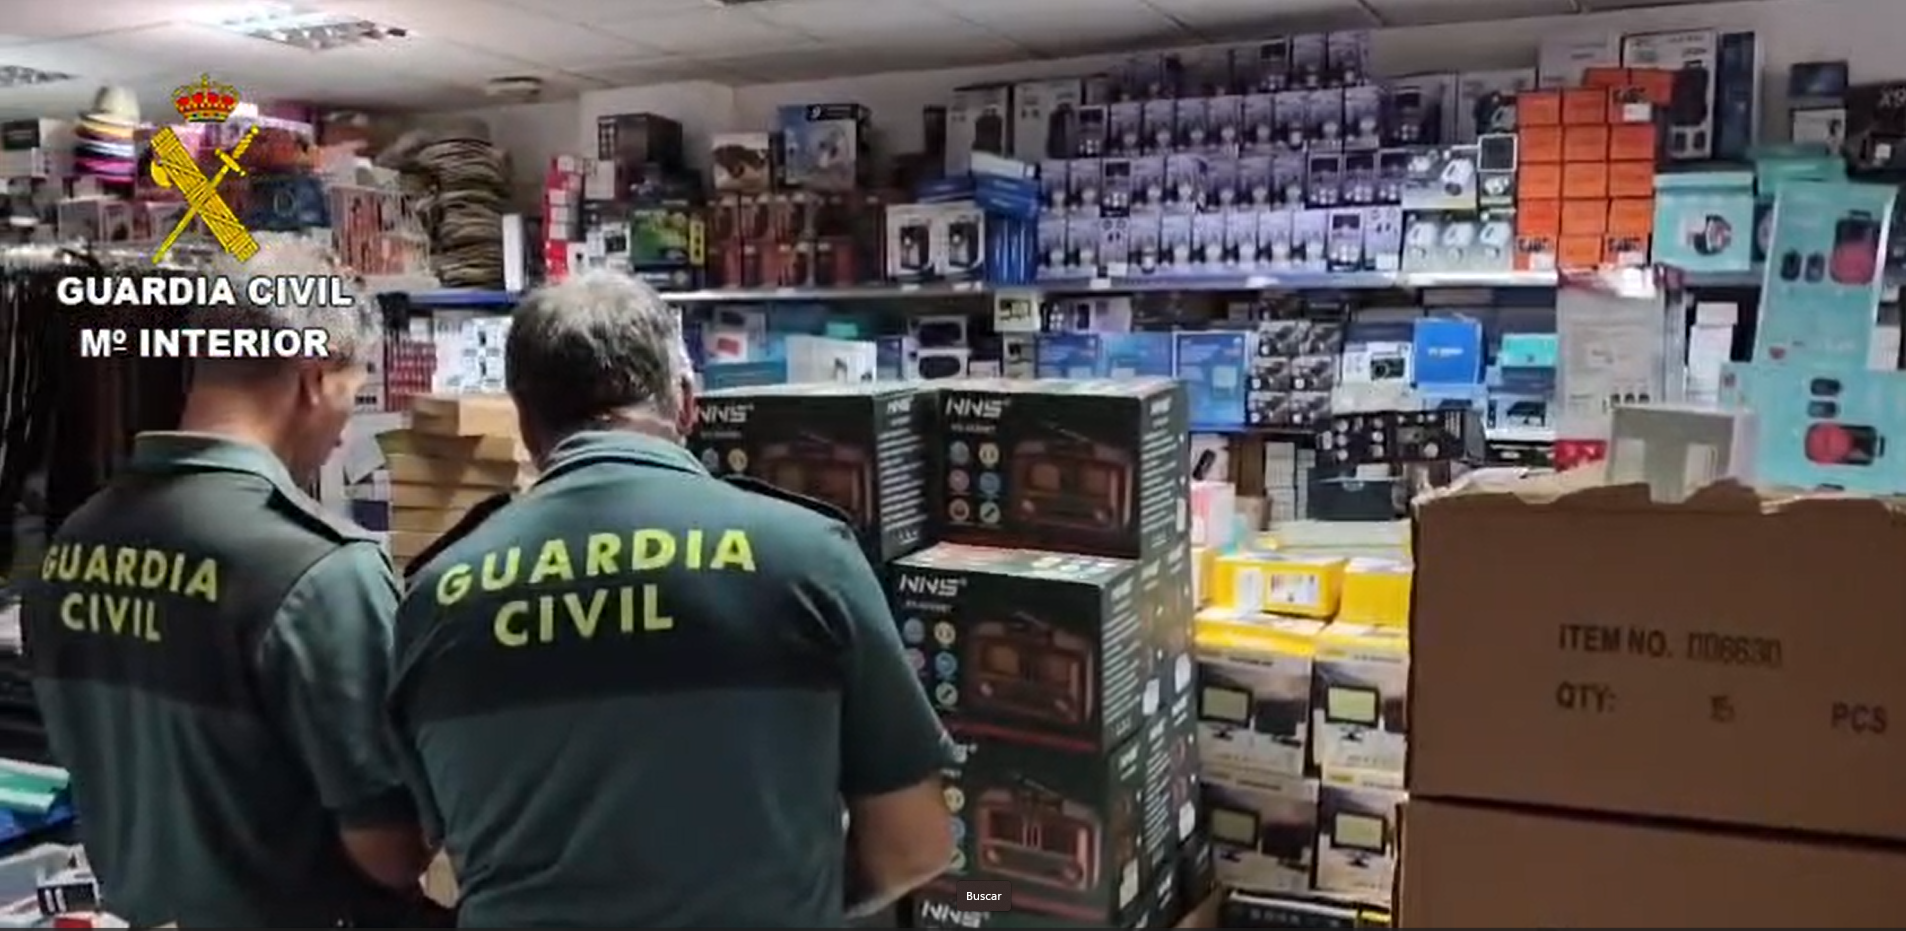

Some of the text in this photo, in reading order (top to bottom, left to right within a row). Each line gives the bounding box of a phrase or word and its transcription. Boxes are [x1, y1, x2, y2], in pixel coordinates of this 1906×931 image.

[42, 543, 217, 603] GUARDIA
[436, 528, 756, 606] GUARDIA
[60, 592, 161, 642] CIVIL
[494, 583, 674, 647] CIVIL
[1558, 624, 1621, 653] ITEM
[1627, 629, 1673, 658] NO.
[1556, 680, 1617, 713] QTY:
[1830, 701, 1888, 735] PCS
